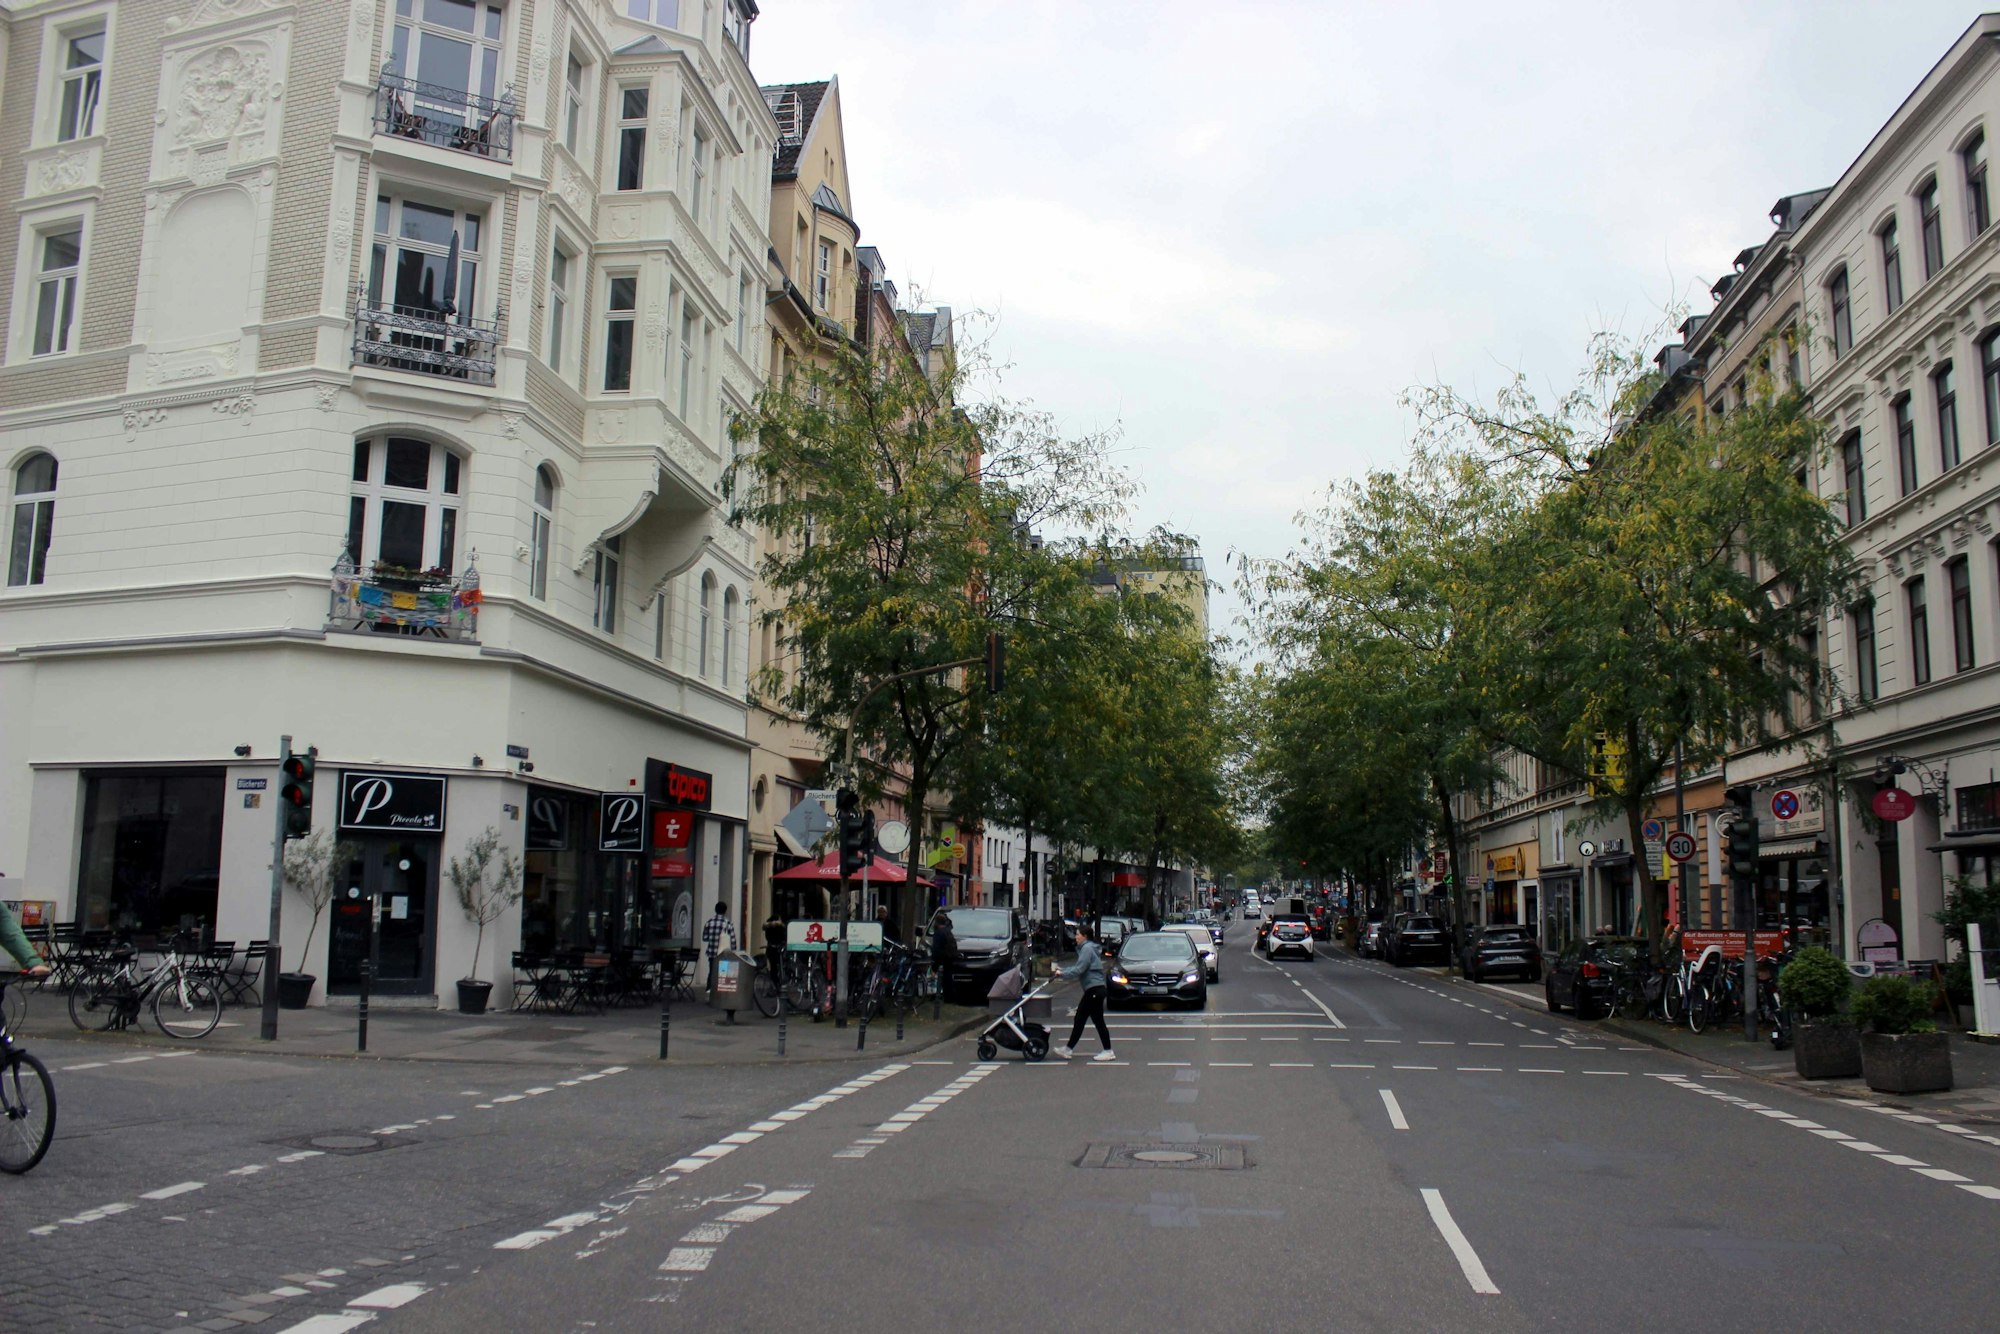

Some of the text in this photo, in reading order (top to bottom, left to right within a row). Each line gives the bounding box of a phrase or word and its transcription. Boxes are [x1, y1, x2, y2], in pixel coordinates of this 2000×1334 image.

[351, 778, 393, 824] P
[668, 763, 707, 804] tipico
[608, 798, 639, 833] P
[1672, 841, 1691, 854] 30
